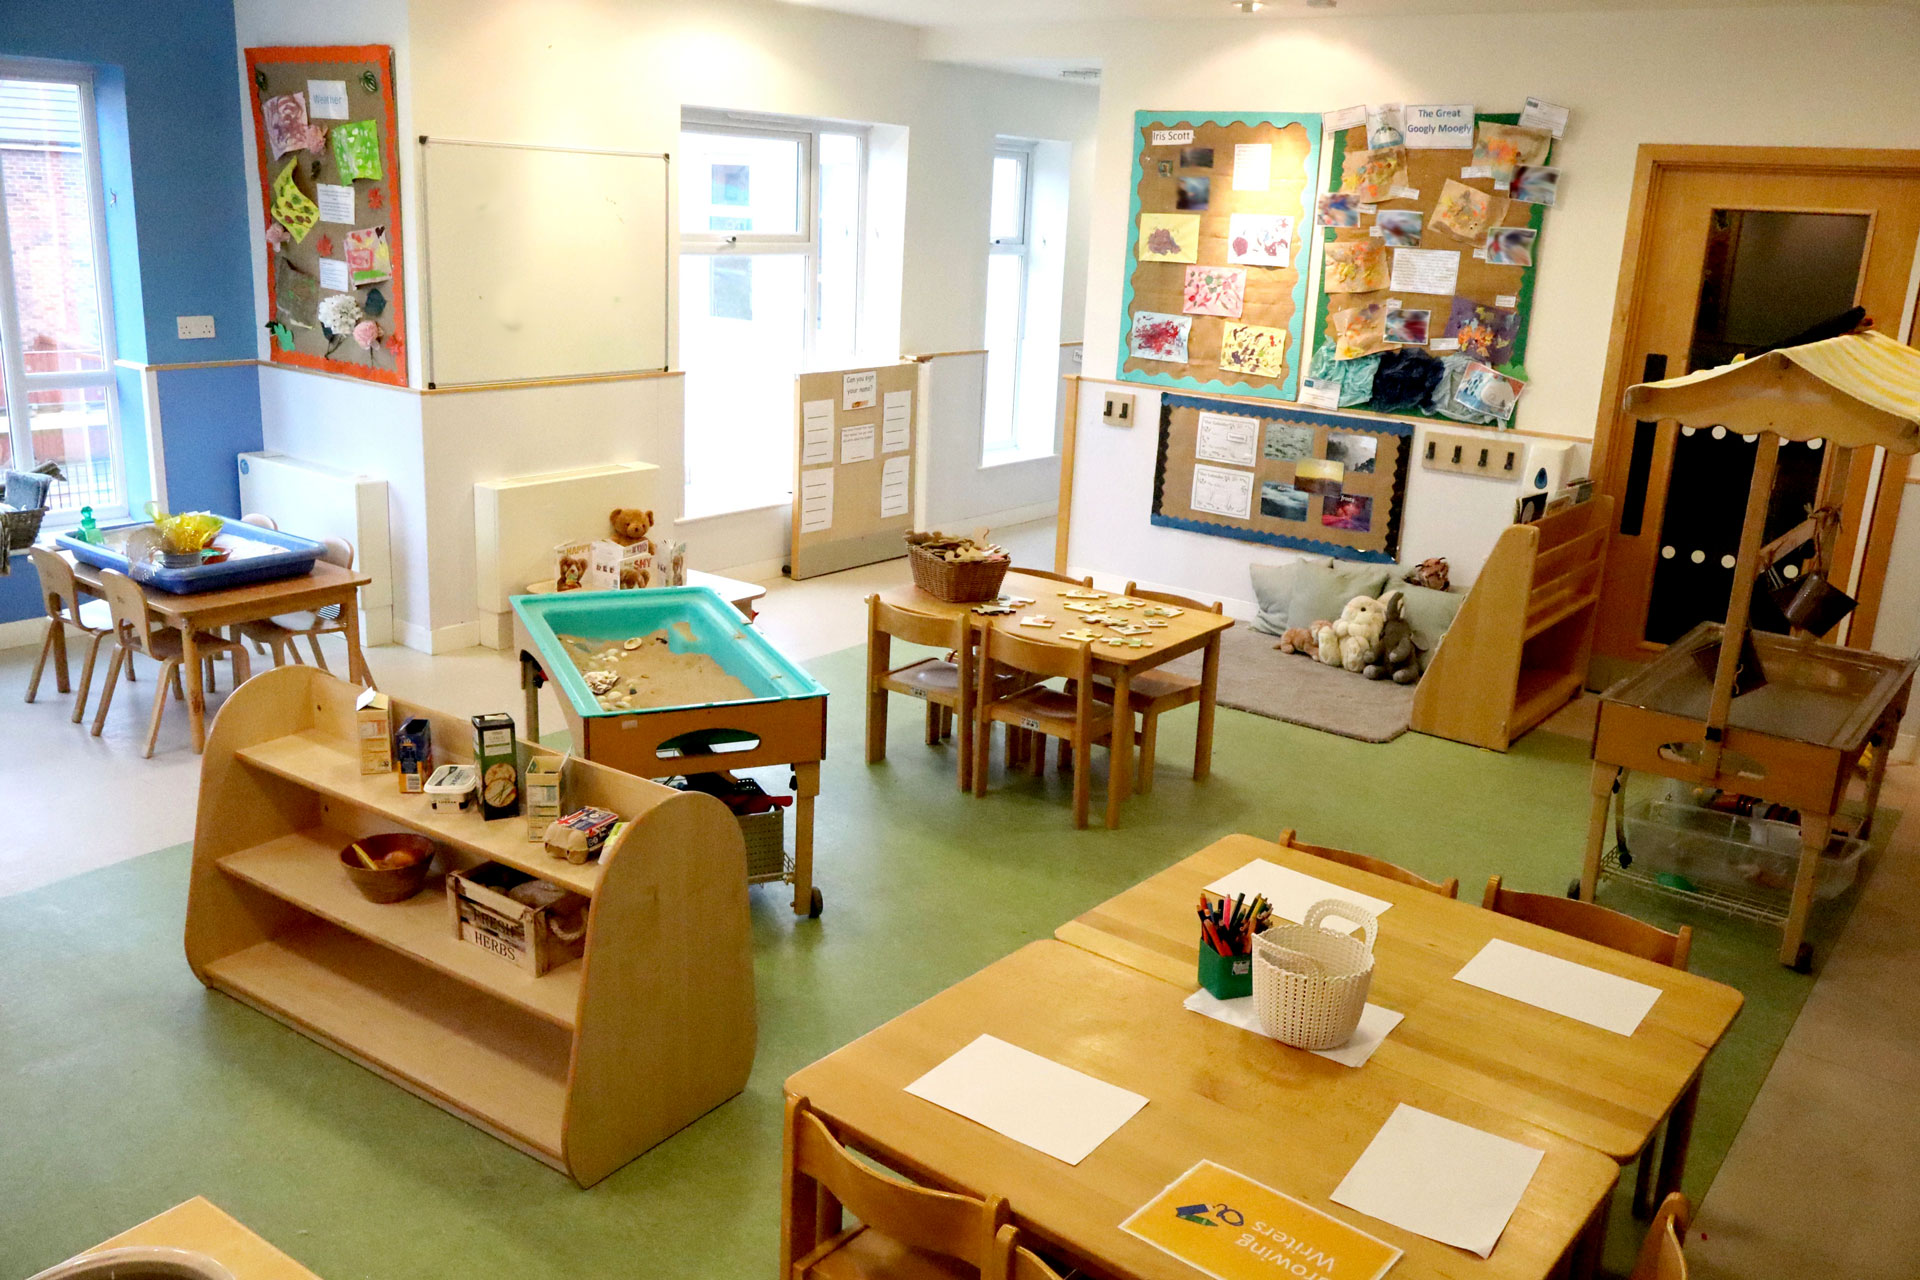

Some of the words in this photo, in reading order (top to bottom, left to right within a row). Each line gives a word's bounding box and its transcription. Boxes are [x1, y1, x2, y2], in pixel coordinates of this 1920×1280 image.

[1418, 109, 1433, 118] The
[1435, 109, 1461, 118] Great
[1407, 124, 1436, 134] Googly
[1438, 124, 1472, 133] Moogly
[1153, 131, 1165, 140] Iris
[1168, 131, 1190, 140] Scott
[566, 543, 591, 555] HAPPY
[634, 558, 652, 568] SHY
[473, 909, 514, 938] FRESH
[474, 930, 516, 961] HERBS
[1251, 1220, 1335, 1273] Writers
